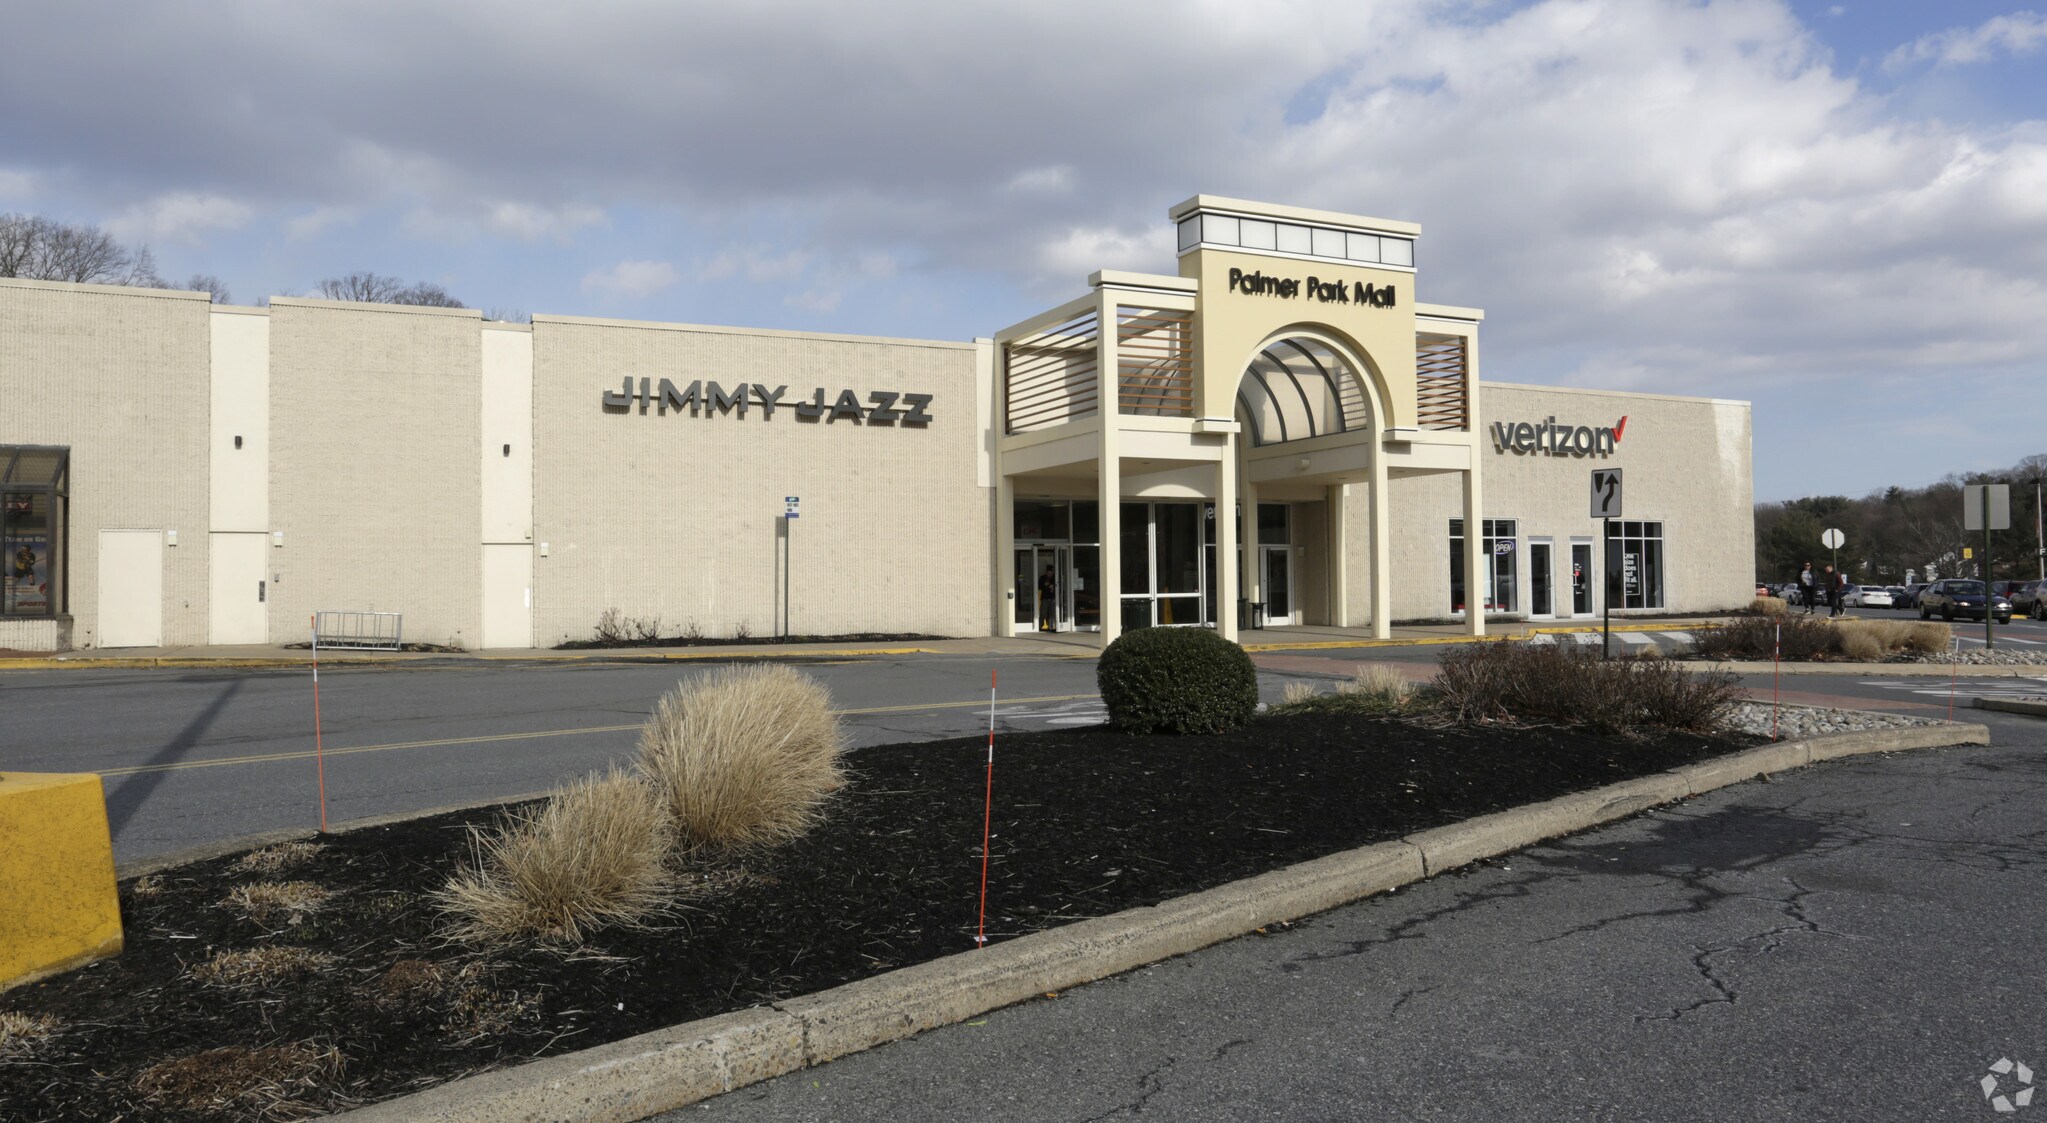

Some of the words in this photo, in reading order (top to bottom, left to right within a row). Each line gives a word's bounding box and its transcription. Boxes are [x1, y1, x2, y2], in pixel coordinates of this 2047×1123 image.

[1229, 267, 1300, 298] Palmer
[1307, 276, 1349, 303] Park
[1354, 281, 1395, 308] Mall
[604, 376, 788, 414] JIMMY
[799, 387, 933, 422] JAZZ
[1493, 415, 1615, 455] verizon
[1495, 543, 1512, 552] OPEN
